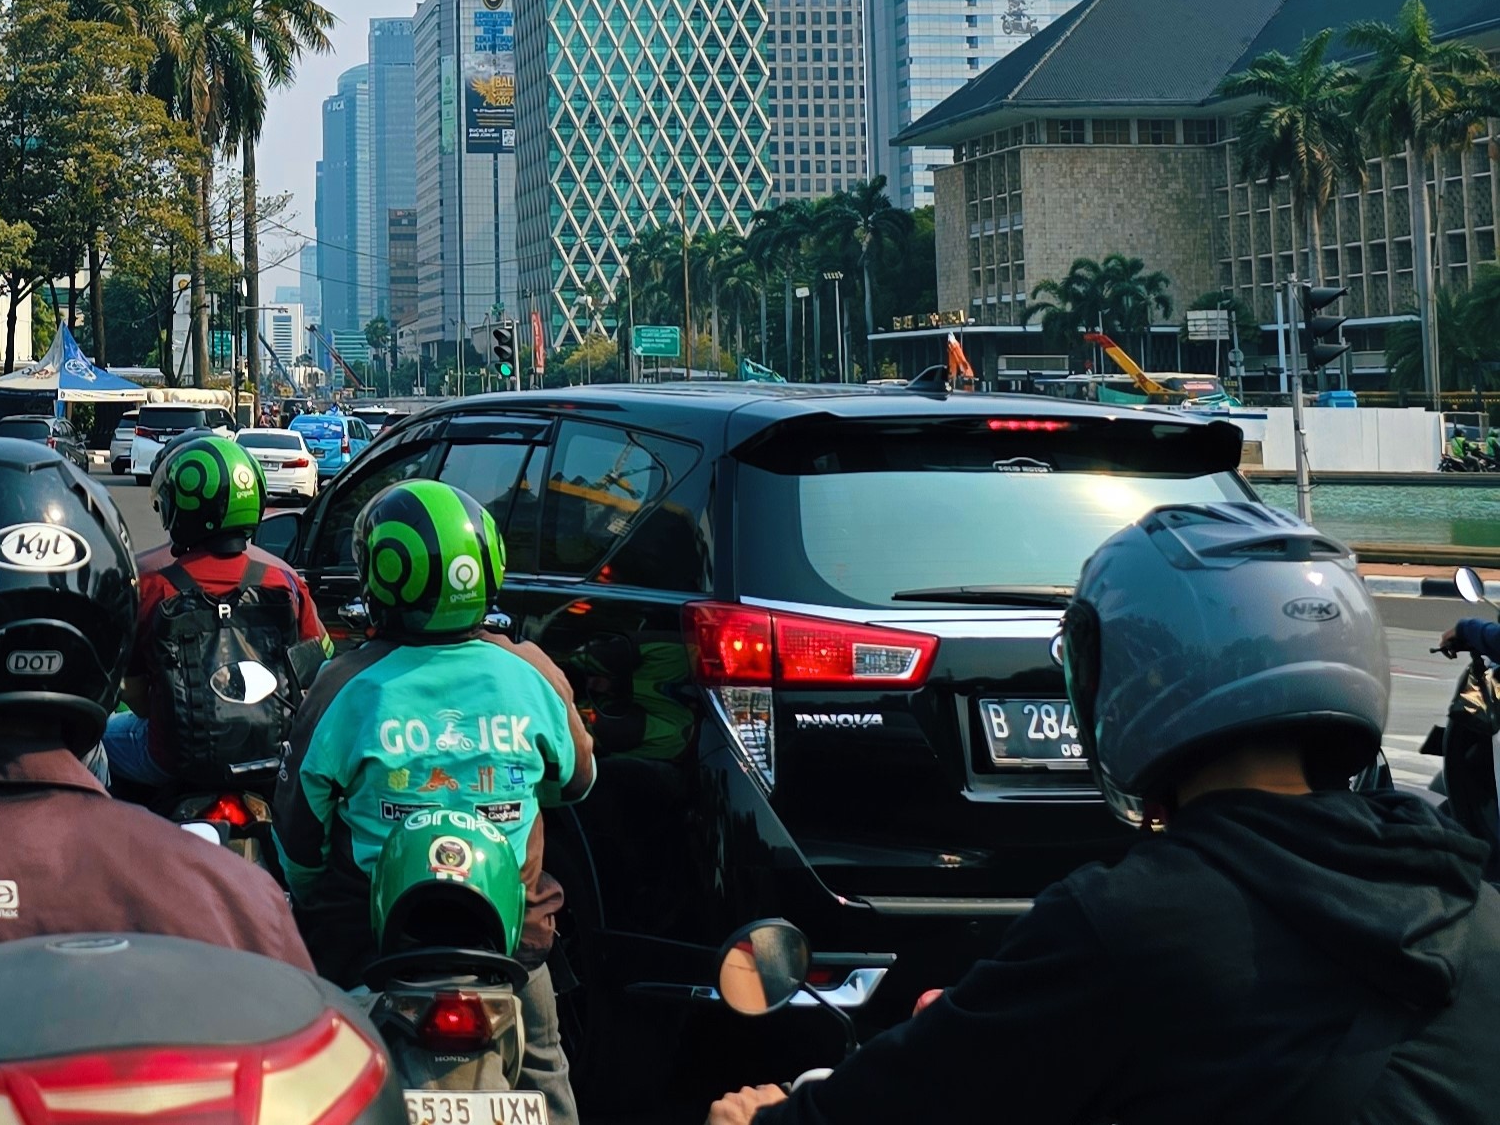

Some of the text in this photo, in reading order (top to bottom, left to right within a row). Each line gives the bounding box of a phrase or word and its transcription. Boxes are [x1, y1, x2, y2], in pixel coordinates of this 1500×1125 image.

[1290, 603, 1332, 615] NHK
[14, 654, 57, 671] DOT
[795, 713, 884, 728] INNOVA
[989, 704, 1078, 739] B 284
[380, 715, 532, 755] GO JEK
[404, 809, 506, 843] Grab
[434, 1055, 470, 1063] HONDA
[490, 1097, 542, 1125] UXM
